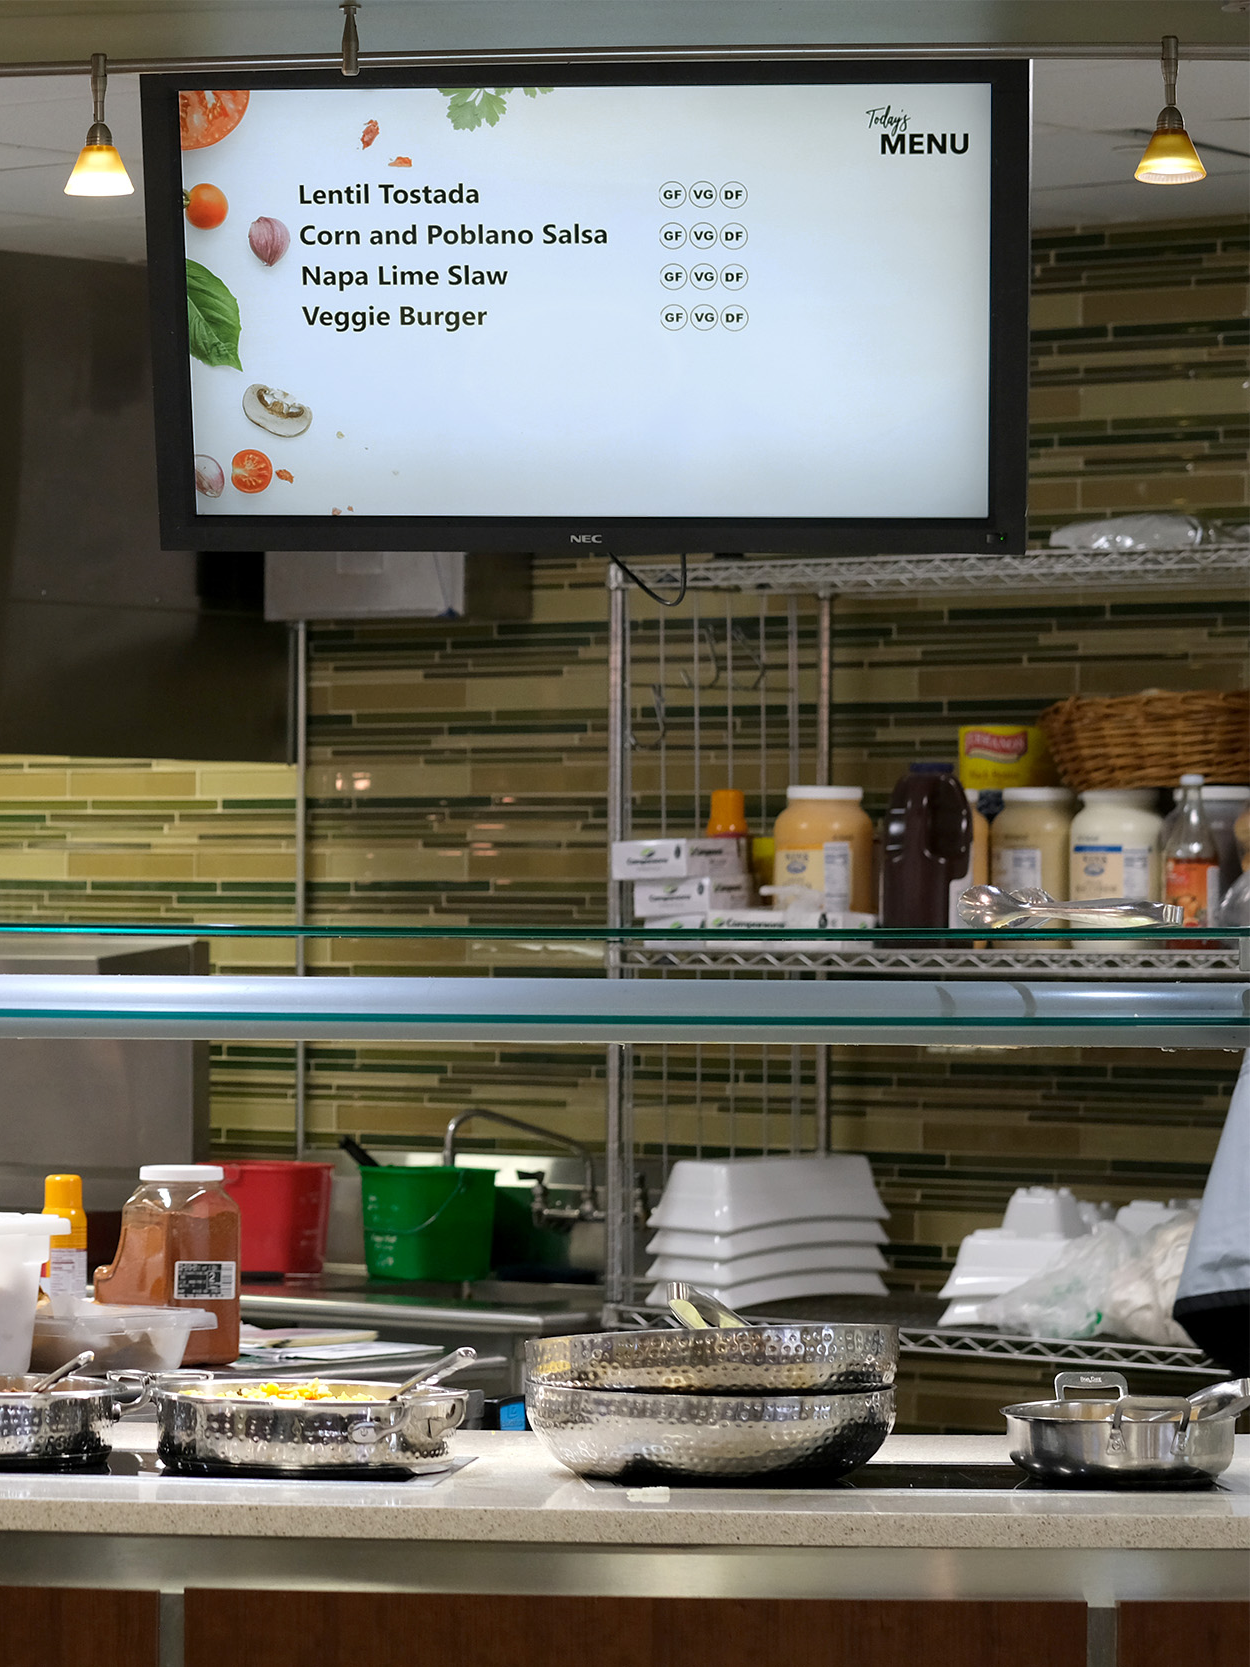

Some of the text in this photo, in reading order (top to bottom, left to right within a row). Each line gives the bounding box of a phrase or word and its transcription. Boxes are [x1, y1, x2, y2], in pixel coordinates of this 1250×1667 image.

[865, 105, 911, 136] Today's
[880, 133, 970, 155] MENU
[298, 183, 480, 205] Lentil Tostada
[663, 190, 743, 200] GF VG DF
[299, 223, 608, 245] Corn and Poblano Salsa
[663, 231, 743, 241] GF VG DF
[301, 264, 508, 291] Napa Lime Slaw
[664, 272, 744, 282] GF VG DF
[302, 305, 488, 333] Veggie Burger
[664, 312, 744, 323] GF VG DF
[570, 534, 603, 544] NEC
